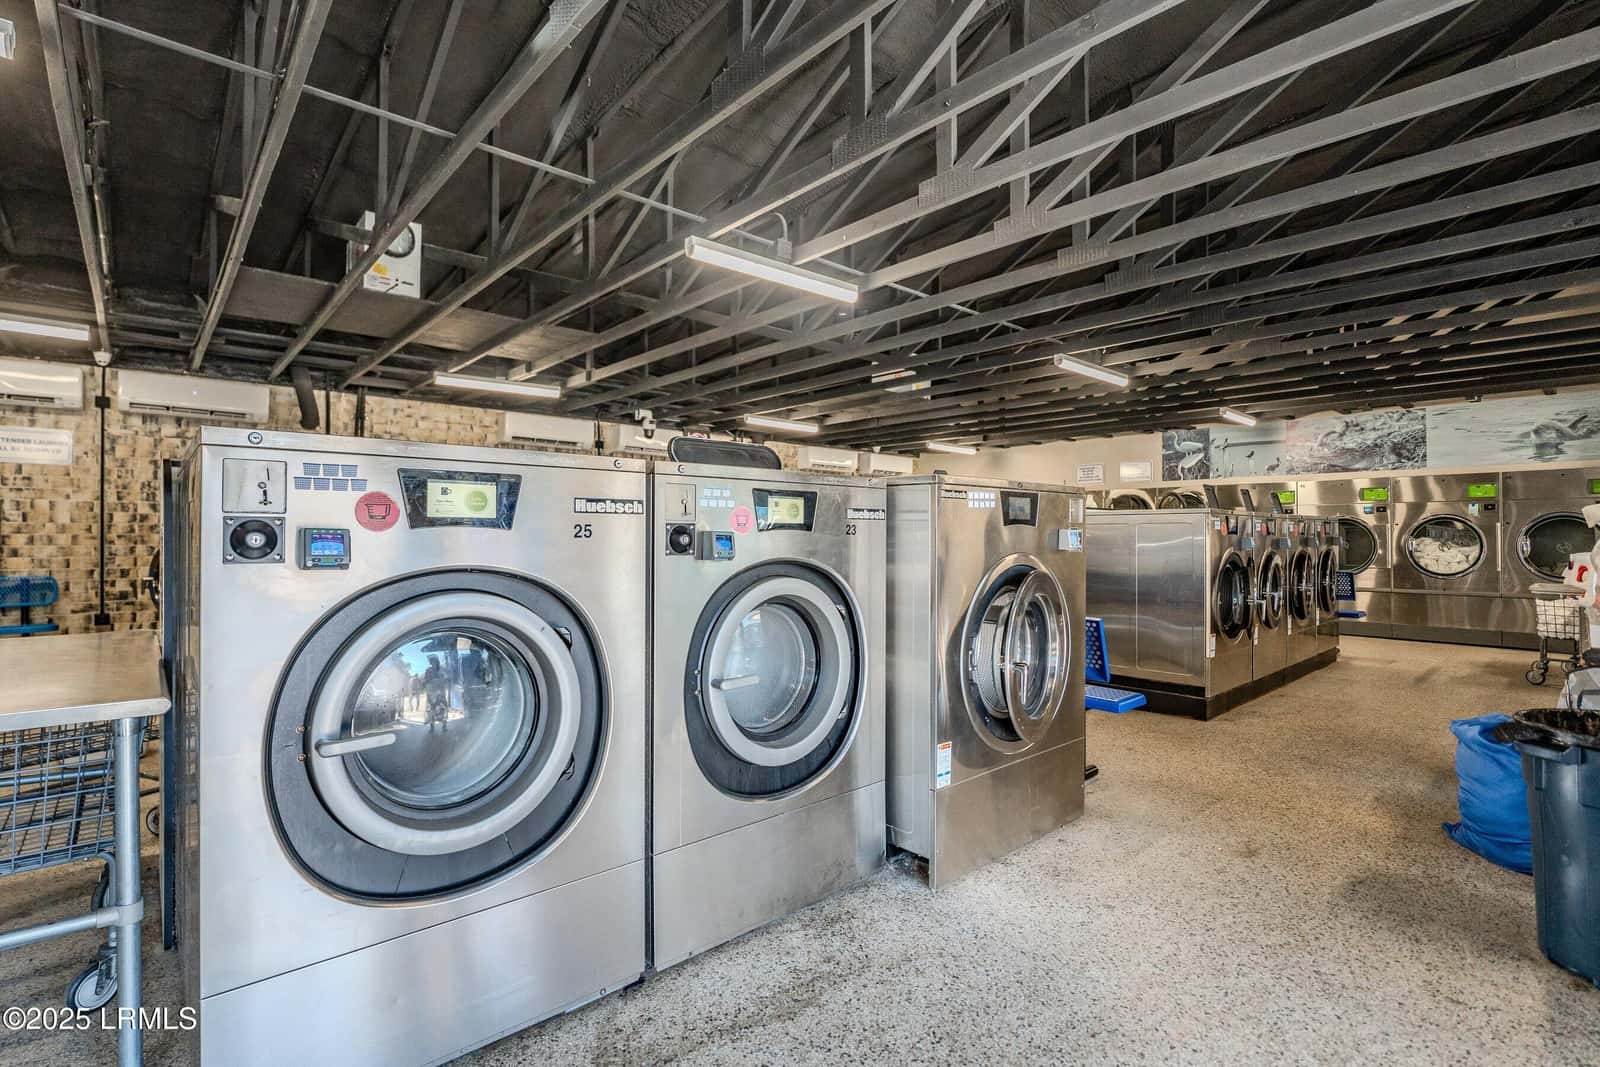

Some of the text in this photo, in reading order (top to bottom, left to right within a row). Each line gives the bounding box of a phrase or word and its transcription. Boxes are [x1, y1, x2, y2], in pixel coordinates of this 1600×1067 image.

[575, 498, 643, 514] Huebsch
[573, 523, 592, 539] 25
[845, 523, 857, 536] 23
